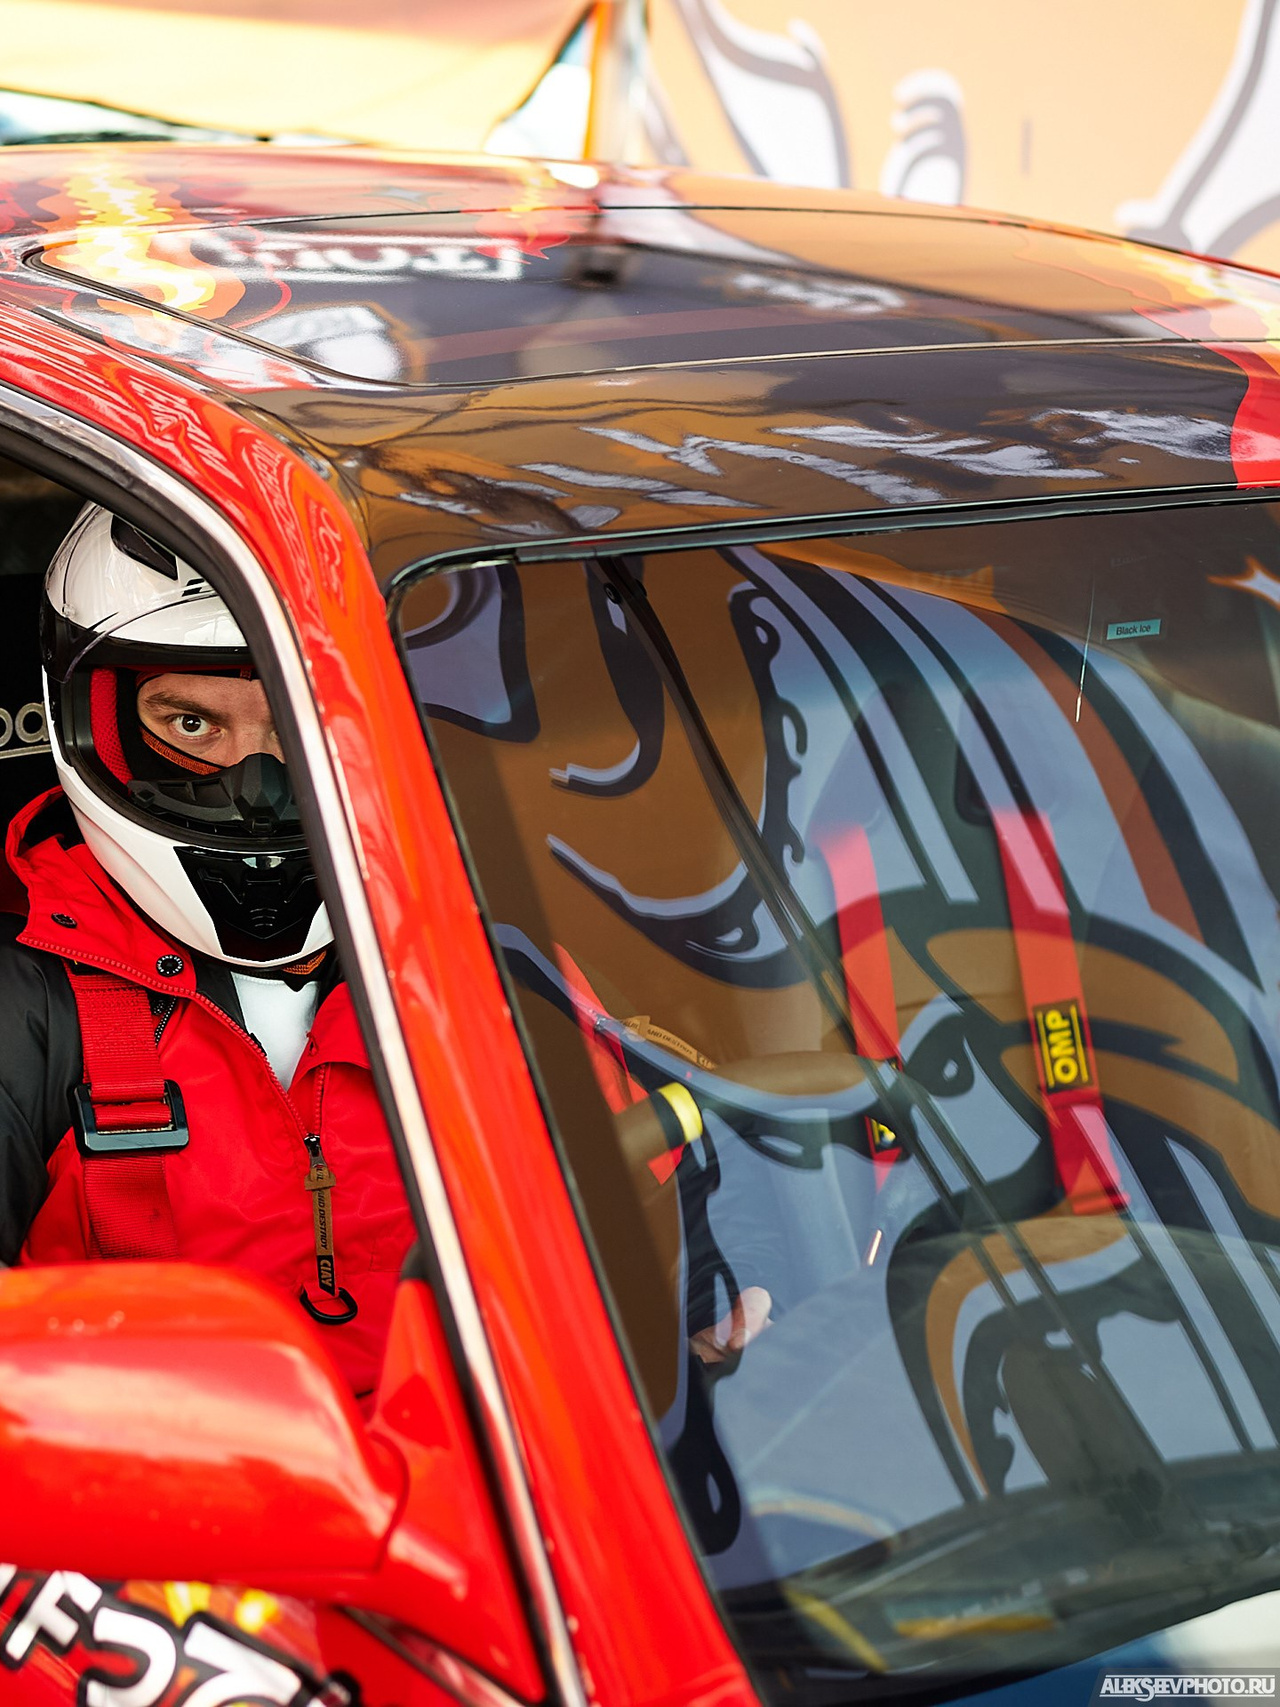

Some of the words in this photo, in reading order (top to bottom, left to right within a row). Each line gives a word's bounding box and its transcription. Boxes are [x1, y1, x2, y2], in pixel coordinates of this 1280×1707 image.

[1116, 625, 1138, 636] Black
[1140, 624, 1151, 633] Ice
[1045, 1009, 1078, 1084] OMP
[318, 1208, 328, 1250] DESTROY
